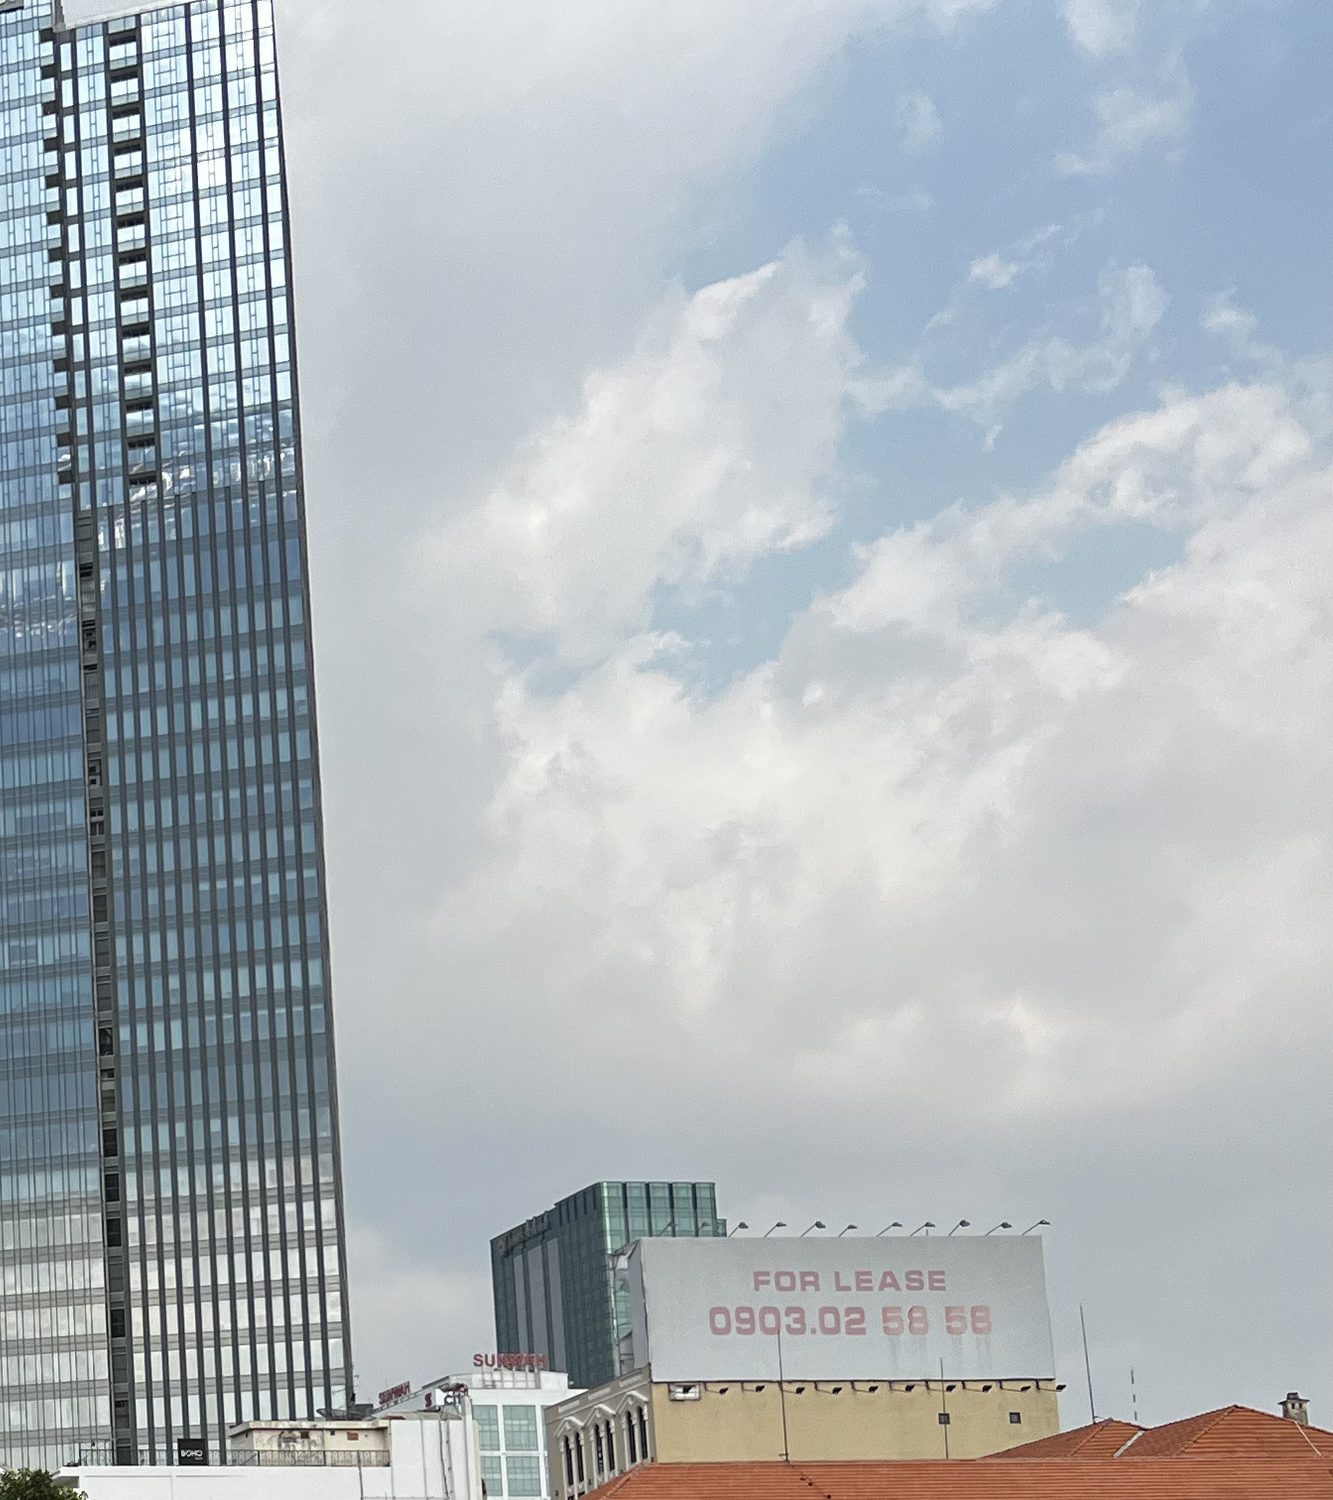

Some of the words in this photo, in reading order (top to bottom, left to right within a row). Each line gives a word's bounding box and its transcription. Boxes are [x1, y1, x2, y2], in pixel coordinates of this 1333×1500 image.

[753, 1271, 820, 1291] FOR
[834, 1270, 946, 1291] LEASE
[709, 1306, 866, 1336] 0903.02
[882, 1305, 929, 1336] 58
[945, 1305, 992, 1336] 58
